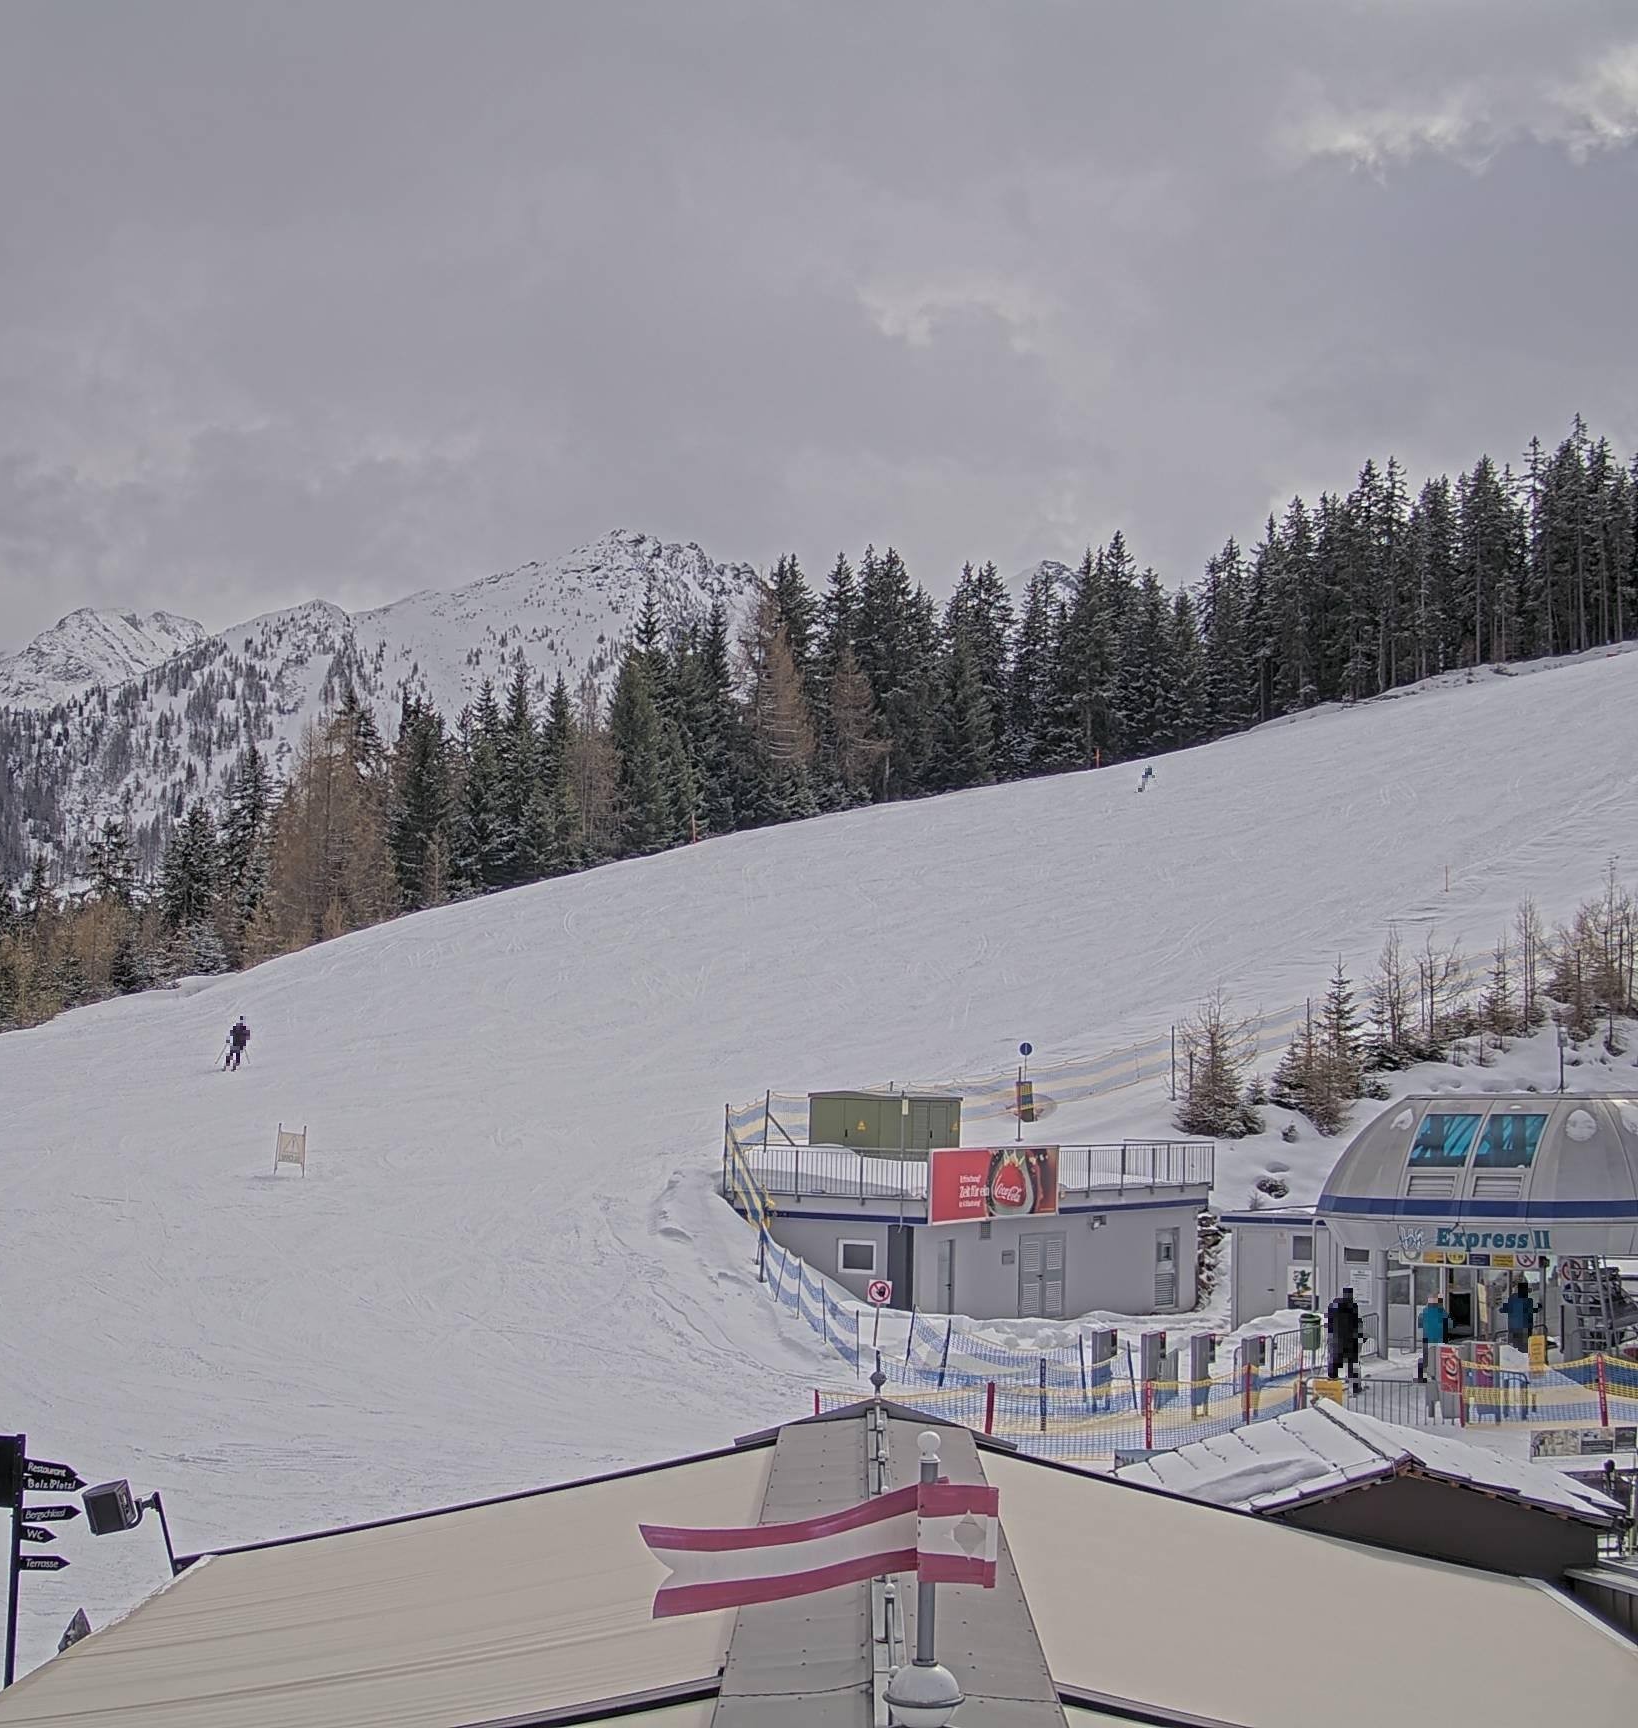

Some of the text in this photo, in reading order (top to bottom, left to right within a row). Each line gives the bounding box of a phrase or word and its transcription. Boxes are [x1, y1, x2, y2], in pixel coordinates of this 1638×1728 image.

[1436, 1227, 1551, 1252] Express II
[27, 1461, 67, 1478] Restaurant
[26, 1528, 45, 1541] WC
[25, 1557, 60, 1569] Terrasse
